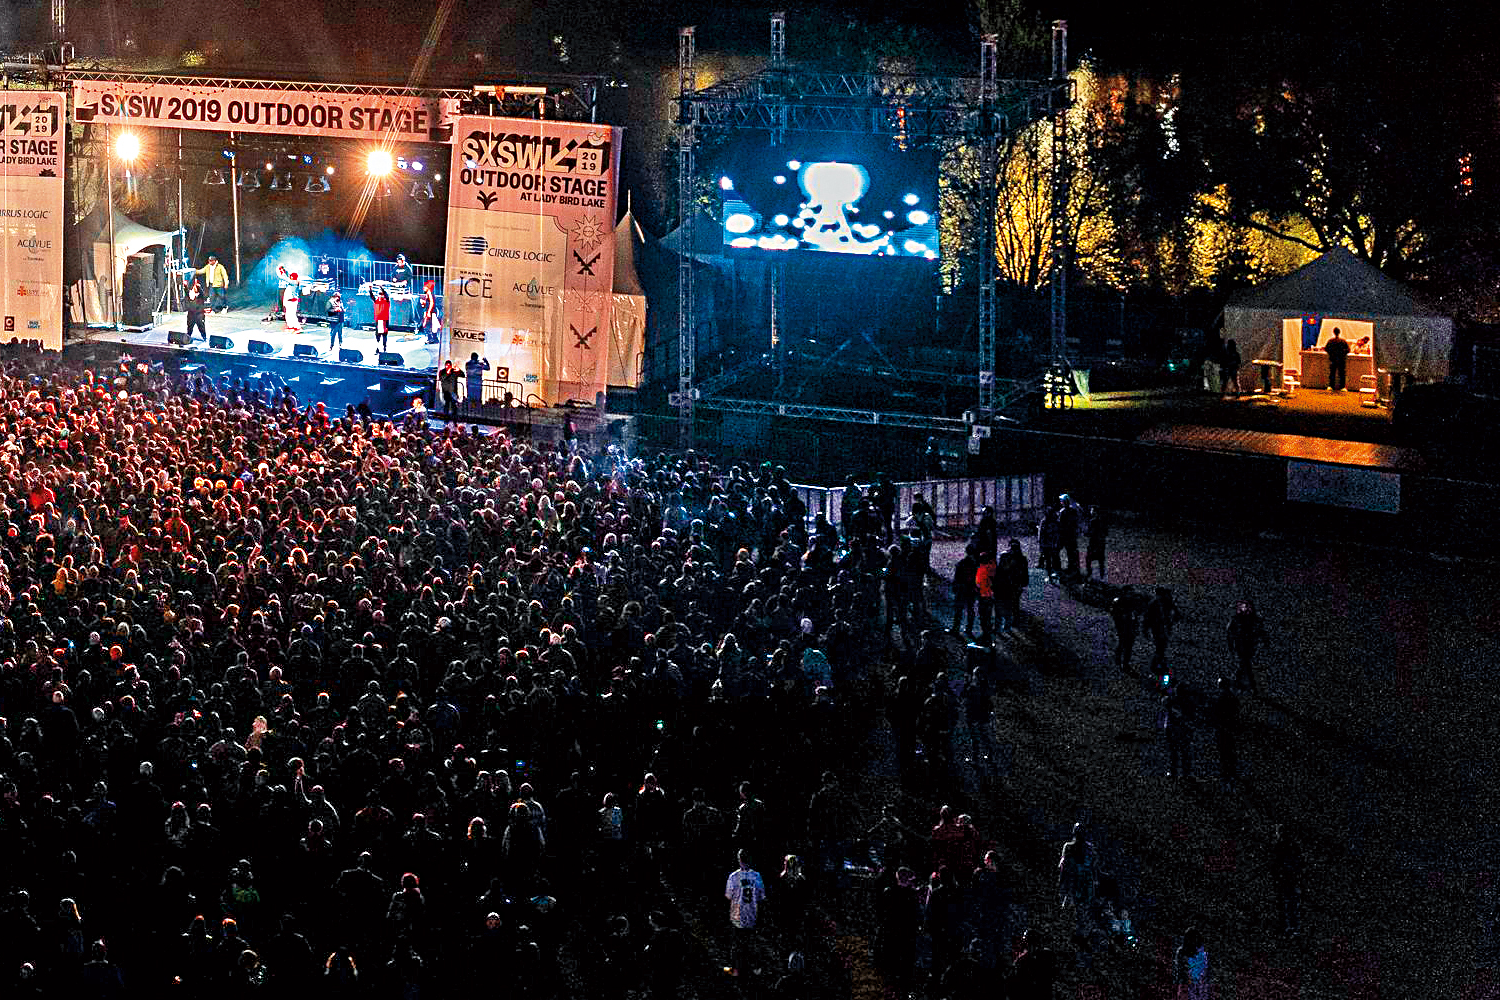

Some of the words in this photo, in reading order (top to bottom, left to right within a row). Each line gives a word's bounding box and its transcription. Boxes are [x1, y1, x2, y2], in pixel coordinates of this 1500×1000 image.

[35, 115, 47, 124] 20
[101, 94, 163, 118] SXSW
[167, 98, 221, 123] 2019
[227, 101, 343, 129] OUTDOOR
[349, 107, 428, 134] STAGE
[35, 125, 47, 133] 19
[10, 139, 58, 156] STAGE
[461, 137, 543, 169] SXSW
[18, 156, 35, 165] BIRD
[37, 157, 57, 166] LAKE
[582, 151, 597, 161] 20
[581, 162, 597, 171] 19
[460, 168, 546, 192] OUTDOOR
[550, 176, 608, 197] STAGE
[520, 191, 531, 201] AT
[534, 193, 557, 204] LADY
[559, 195, 580, 206] BIRD
[581, 197, 606, 208] LAKE
[23, 209, 50, 219] LOGIC
[17, 239, 52, 249] ACUVUE
[488, 247, 521, 260] CIRRUS
[523, 250, 553, 263] LOGIC
[458, 276, 493, 299] ICE
[512, 282, 555, 296] ACUVUE
[453, 329, 478, 340] KVUE
